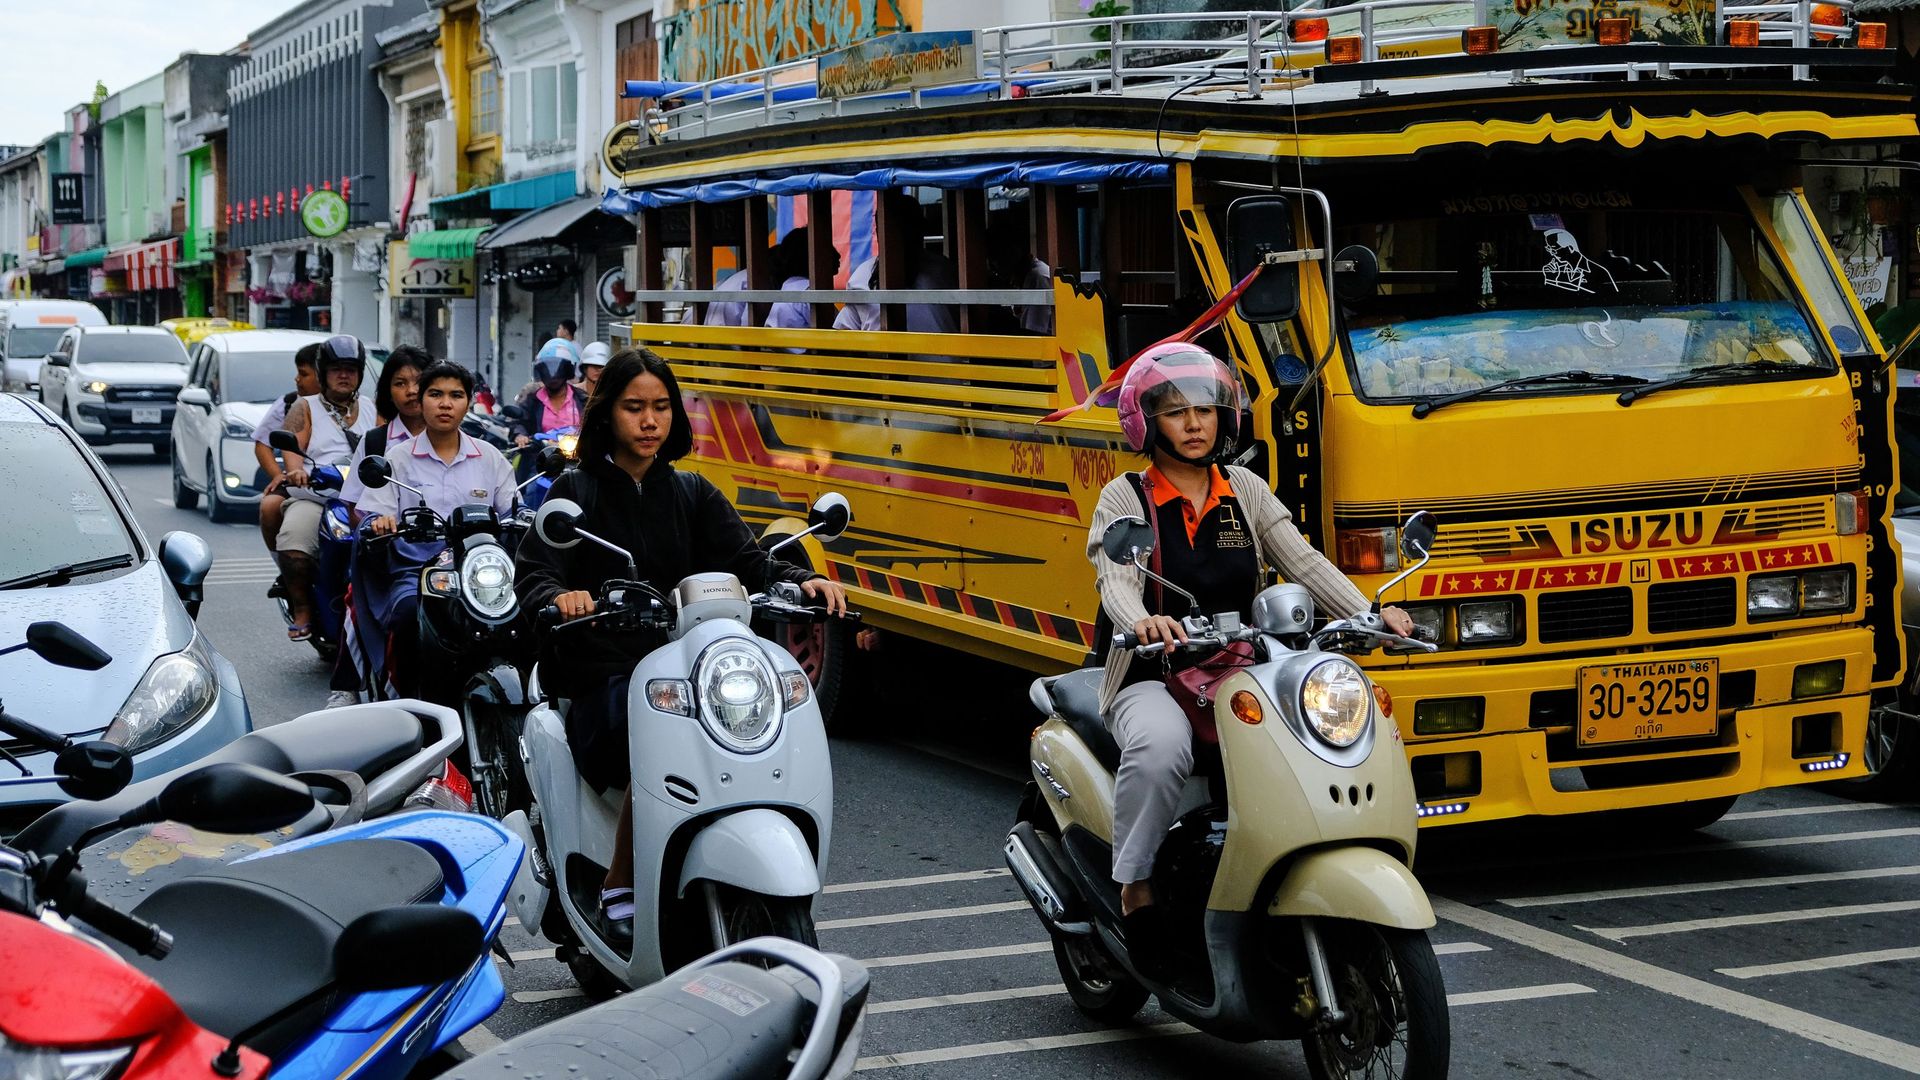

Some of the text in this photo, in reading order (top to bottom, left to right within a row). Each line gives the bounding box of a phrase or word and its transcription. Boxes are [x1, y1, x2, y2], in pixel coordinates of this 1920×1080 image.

[1570, 511, 1704, 555] ISUZU
[1613, 663, 1687, 678] THAILAND
[1588, 676, 1710, 721] 30-3259
[1634, 720, 1664, 738] ภูเก็ต
